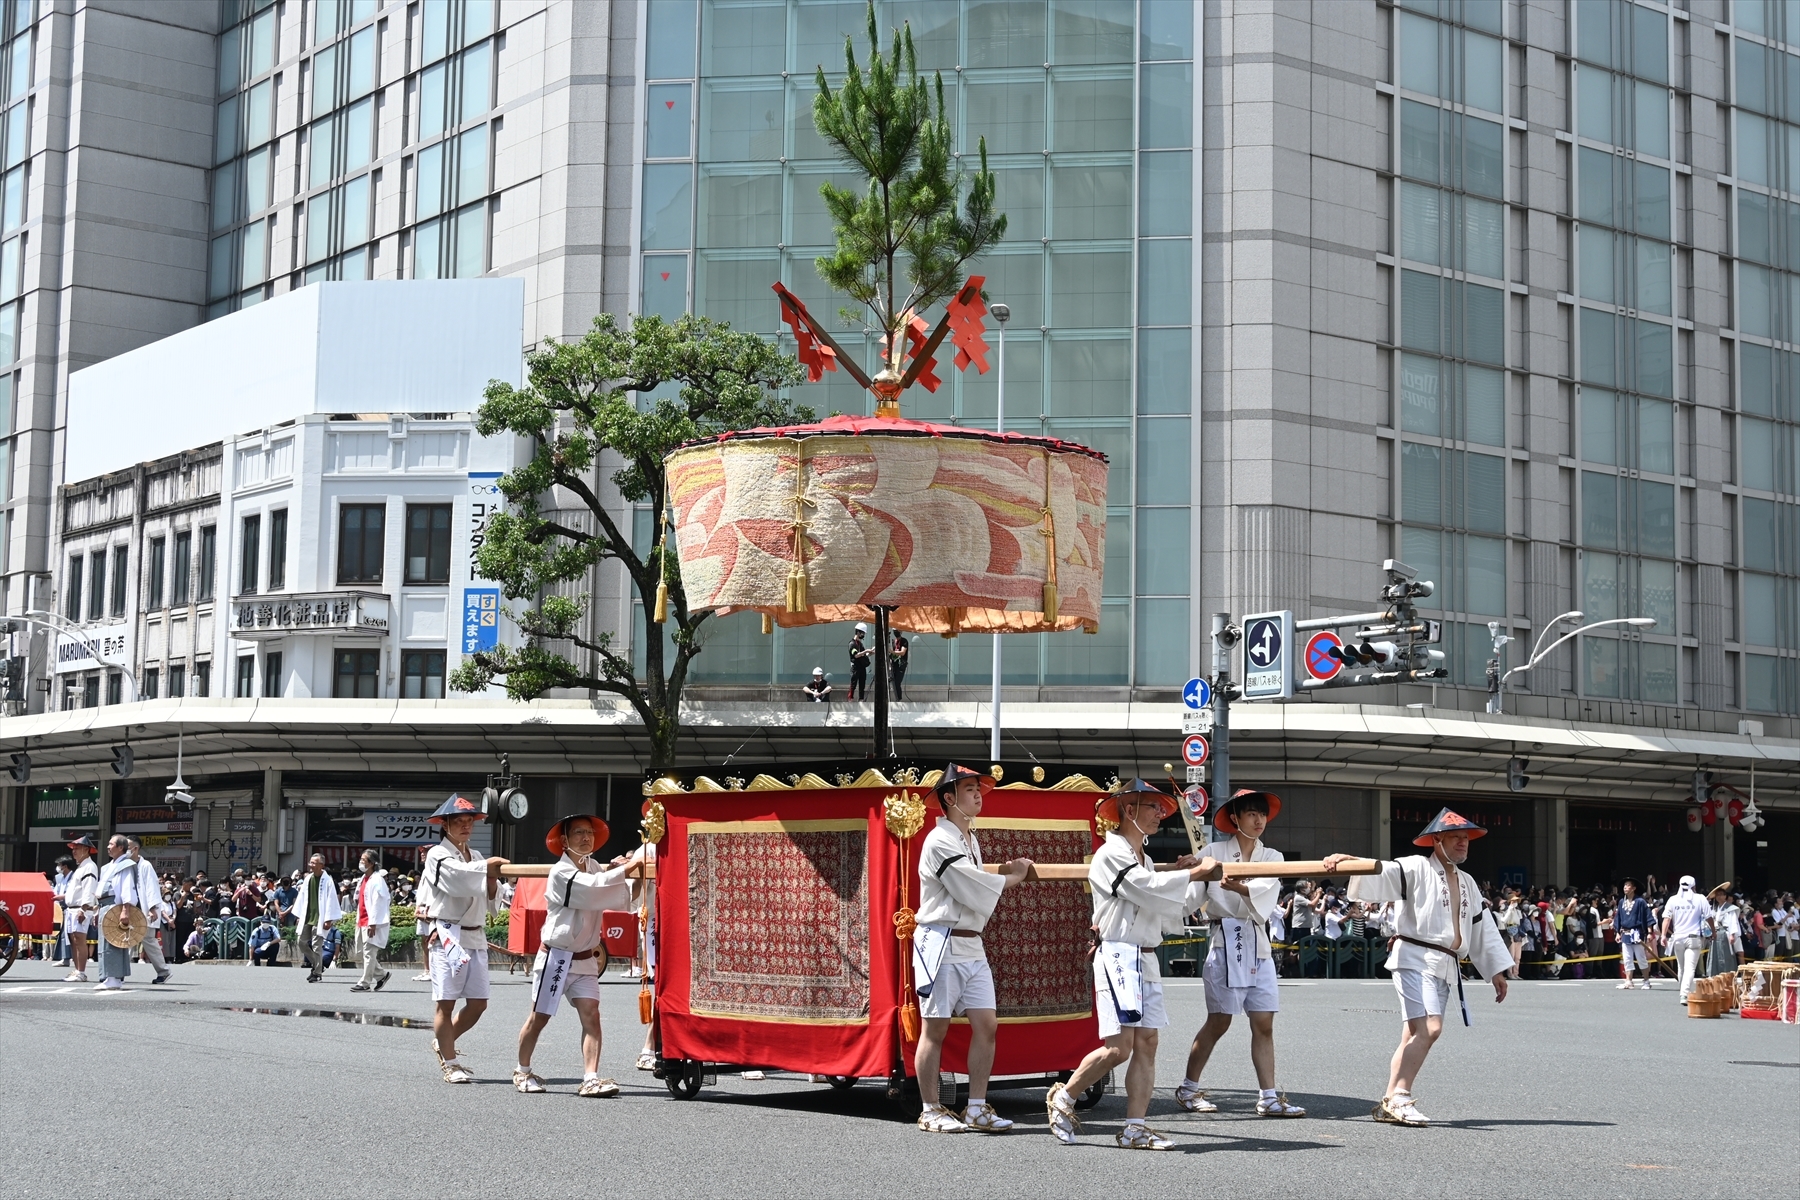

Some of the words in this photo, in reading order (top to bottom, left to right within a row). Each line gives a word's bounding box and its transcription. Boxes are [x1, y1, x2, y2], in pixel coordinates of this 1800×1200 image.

[236, 601, 350, 628] 池善化粧品店
[482, 596, 494, 625] すぐ
[465, 594, 481, 652] 買えます
[104, 635, 125, 656] 雲の茶
[37, 799, 78, 819] MARUMARU
[375, 826, 440, 839] コンタクト
[1503, 872, 1523, 885] 入口
